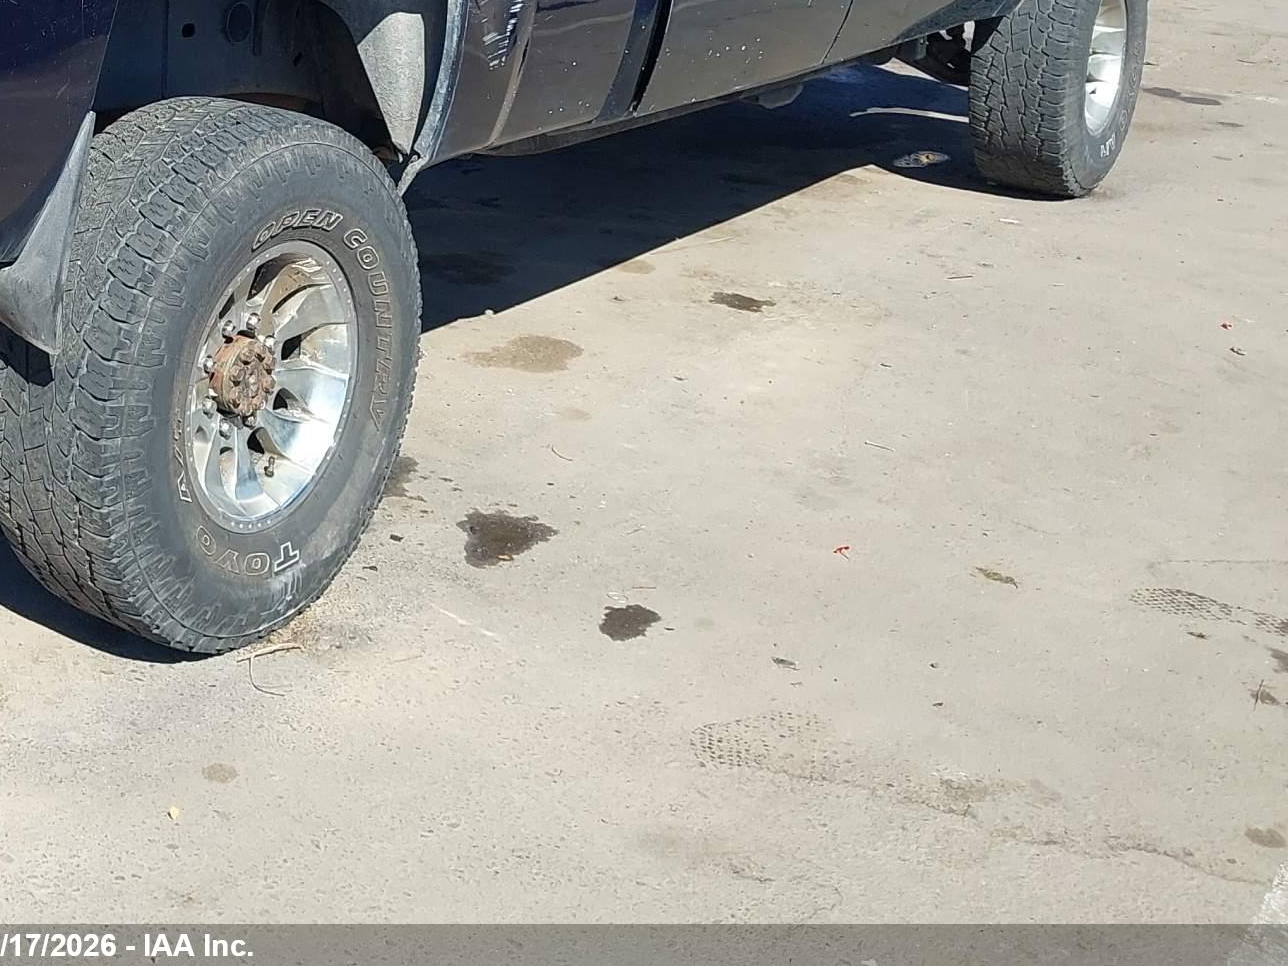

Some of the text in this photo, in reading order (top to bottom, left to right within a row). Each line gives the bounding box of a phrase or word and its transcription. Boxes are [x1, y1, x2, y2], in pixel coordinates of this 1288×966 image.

[251, 208, 393, 433] OPEN COUNTRY
[195, 524, 300, 577] TOYO
